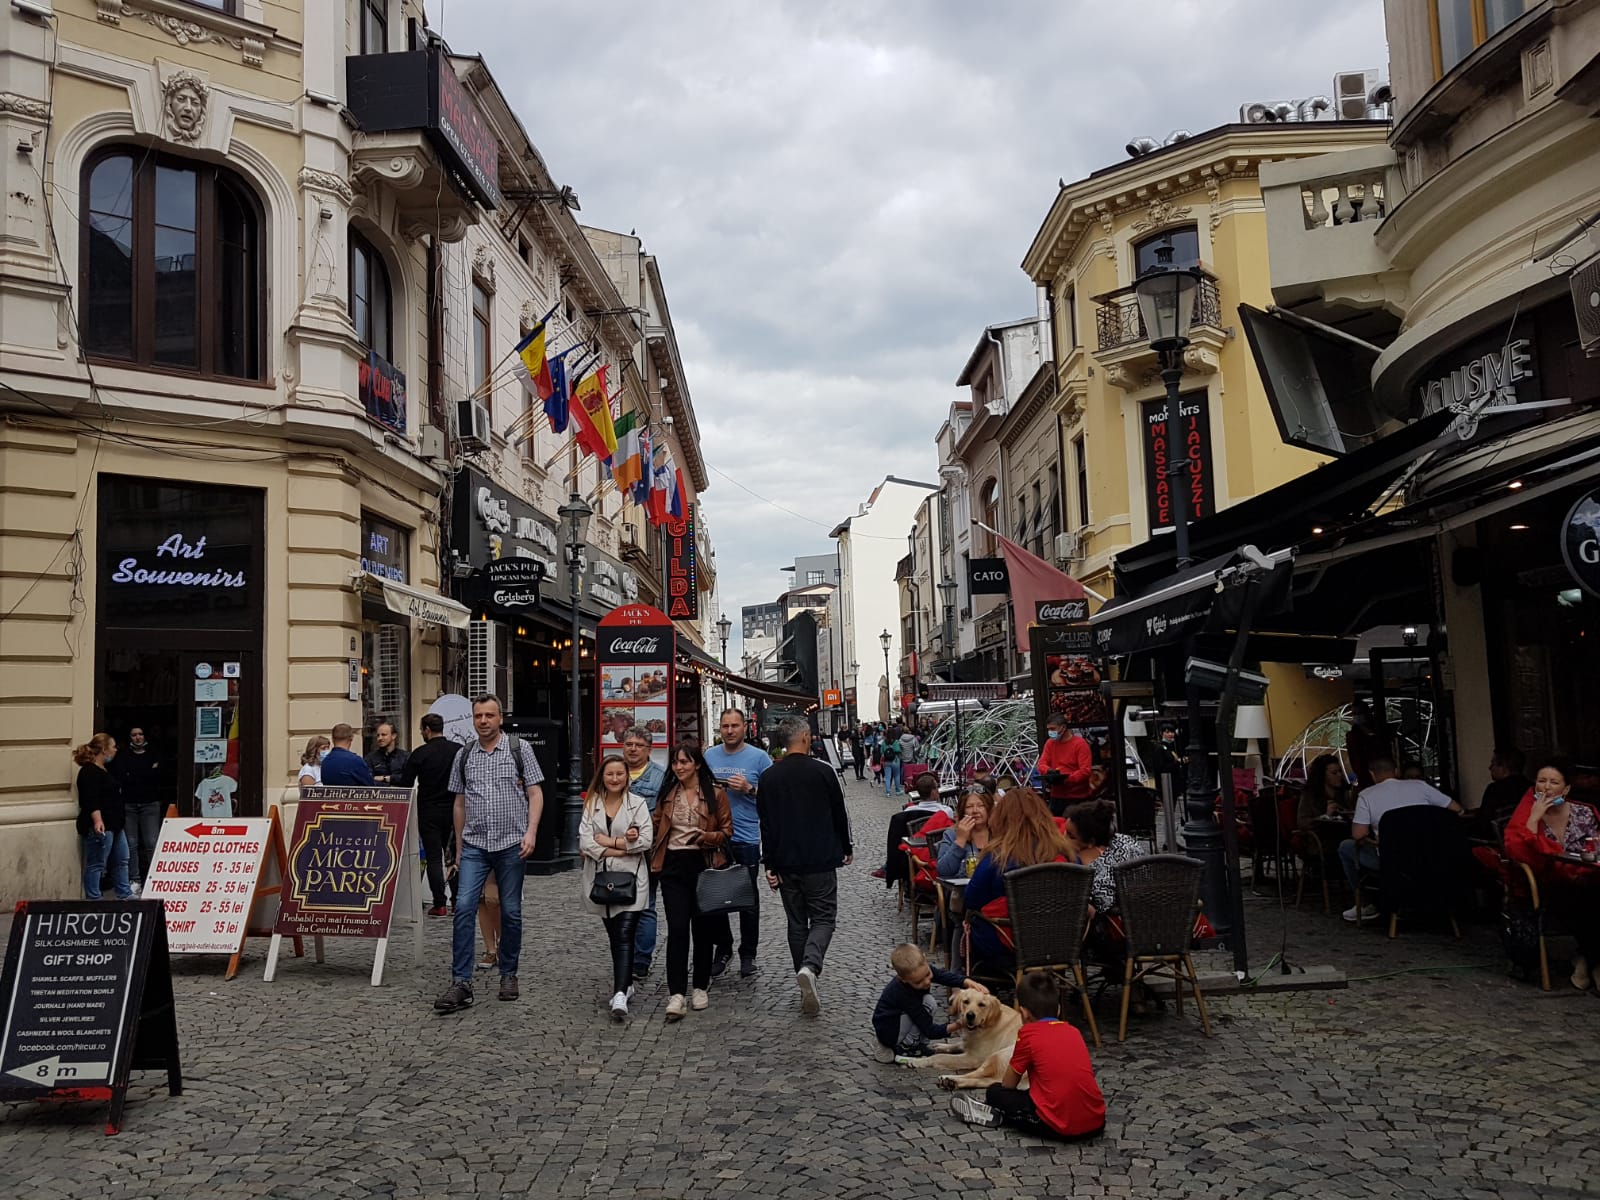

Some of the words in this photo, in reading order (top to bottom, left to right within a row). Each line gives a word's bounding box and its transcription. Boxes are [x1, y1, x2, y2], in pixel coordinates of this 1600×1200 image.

[441, 116, 460, 147] OPEN
[1149, 405, 1200, 423] MONTS
[1151, 422, 1169, 523] MASSAGE
[1187, 415, 1204, 518] JACUZZI
[156, 533, 207, 559] Art
[370, 531, 389, 556] ART
[111, 557, 246, 588] Souvenirs
[488, 562, 519, 574] JACK'S
[520, 562, 540, 572] PUB
[667, 519, 690, 617] GILDA
[973, 571, 1004, 582] CATO
[493, 589, 535, 607] Carlsberg
[620, 607, 651, 617] JACK'S
[1039, 601, 1086, 621] Coca-Cola
[609, 636, 660, 654] Coca-Cola
[306, 788, 323, 798] The
[322, 789, 348, 799] Little
[348, 789, 370, 800] Paris
[369, 790, 407, 800] Museum
[317, 831, 378, 847] Muzeul
[162, 841, 211, 854] BRANDED
[212, 841, 259, 854] CLOTHES
[156, 861, 200, 873] BLOUSES
[211, 861, 224, 874] 15
[229, 861, 242, 874] 35
[242, 861, 255, 874] lei
[151, 880, 200, 893] TROUSERS
[205, 881, 218, 893] 25
[224, 881, 236, 893] 55
[236, 881, 250, 894] lei
[200, 900, 213, 913] 25
[218, 900, 231, 913] 55
[231, 901, 244, 913] lei
[36, 912, 133, 936] HIRCUS
[282, 912, 314, 923] Probabil
[315, 913, 327, 923] cel
[327, 916, 343, 924] mai
[343, 915, 369, 925] frumos
[369, 915, 382, 926] loc
[212, 921, 226, 933] 35
[226, 921, 238, 934] lei
[296, 924, 309, 934] din
[309, 923, 340, 934] Centrul
[340, 924, 365, 935] Istoric
[43, 954, 74, 966] GIFT
[75, 953, 113, 965] SHOP
[36, 1065, 49, 1078] 8
[56, 1065, 78, 1077] m
